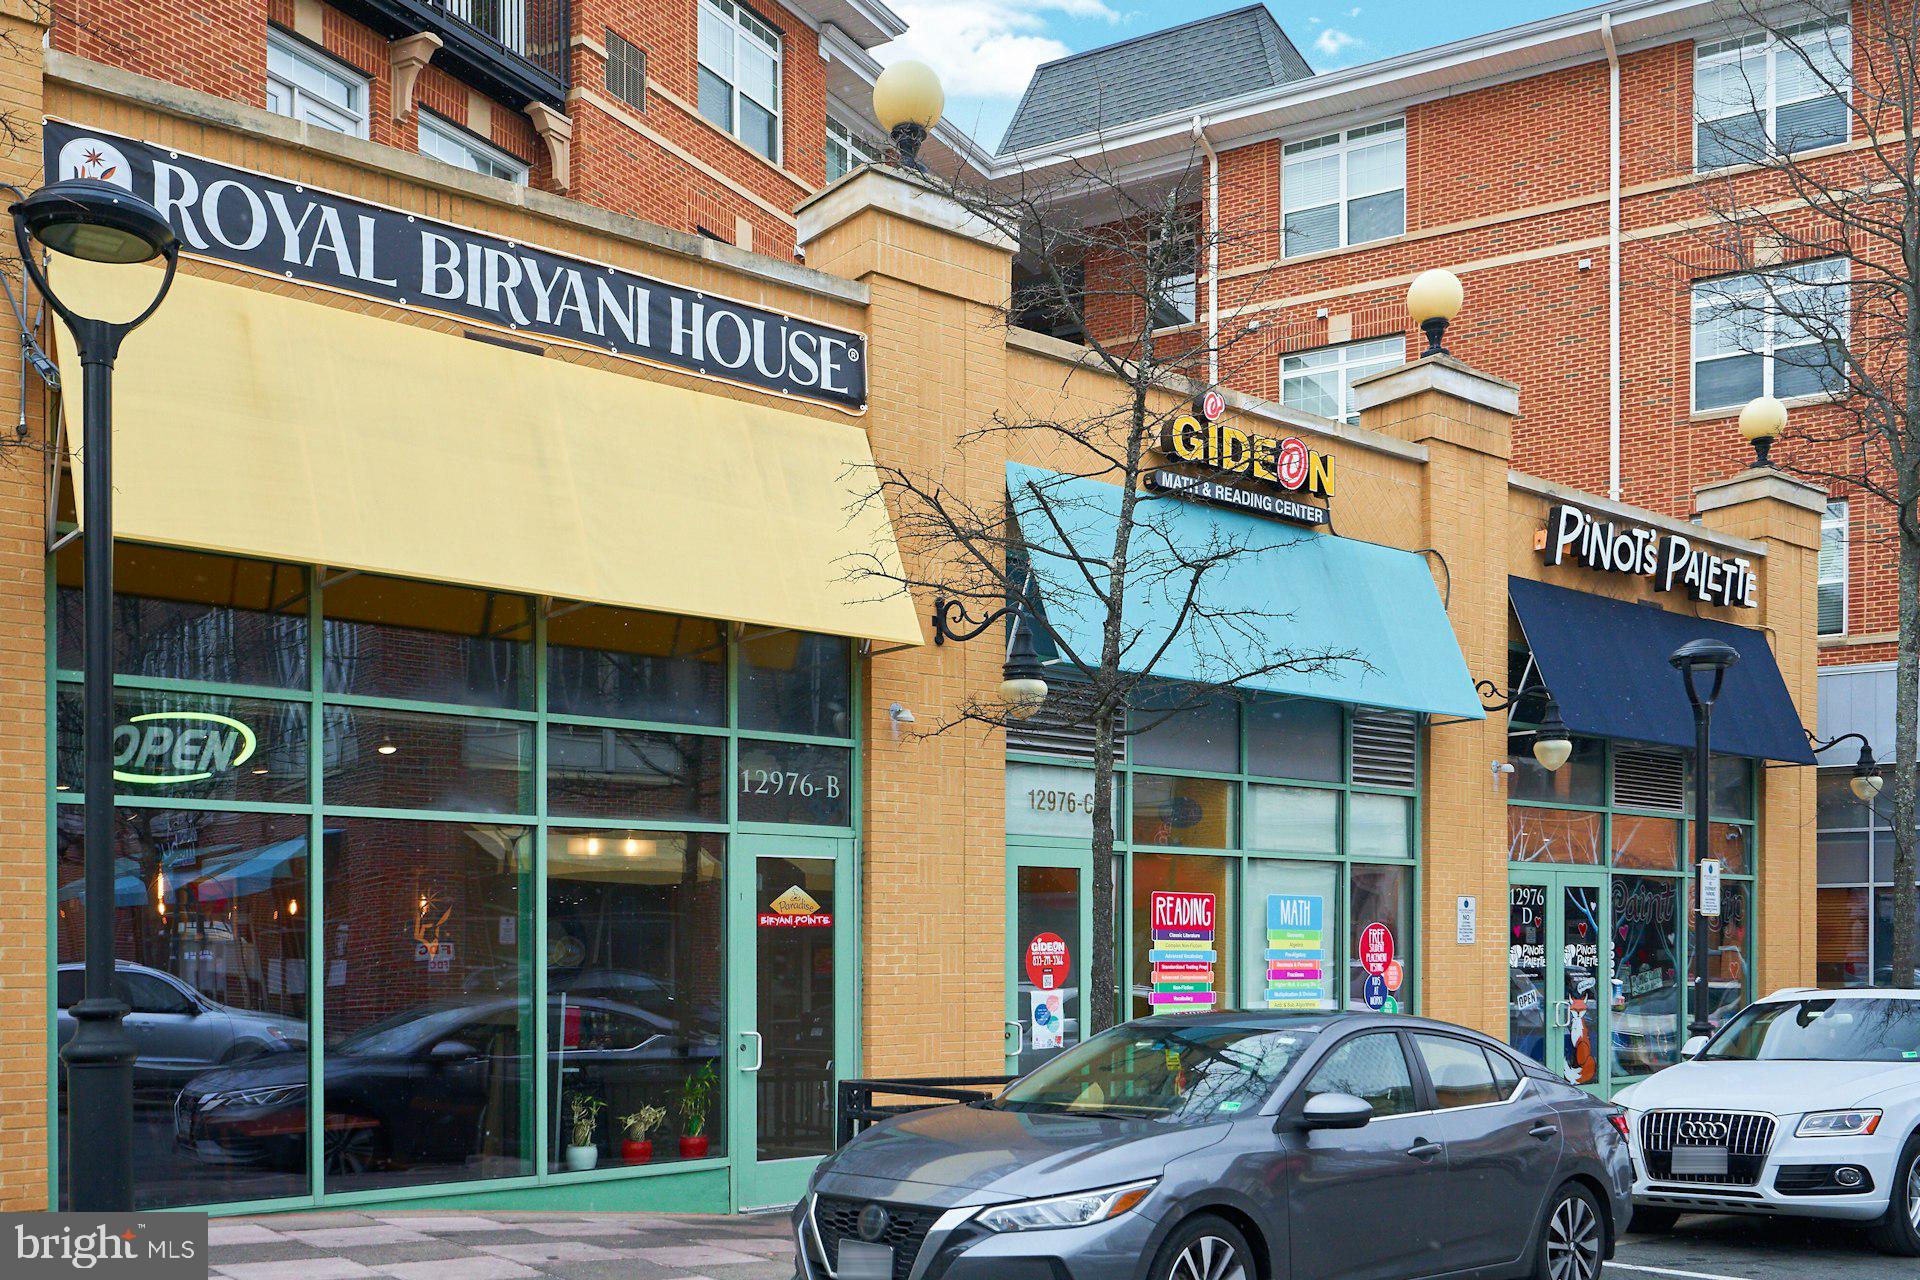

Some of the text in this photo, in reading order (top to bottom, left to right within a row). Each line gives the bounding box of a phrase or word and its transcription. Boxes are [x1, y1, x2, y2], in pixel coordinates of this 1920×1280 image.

[152, 160, 397, 288] ROYAL
[420, 231, 651, 347] BIRYANI
[1162, 472, 1323, 523] MATH & READING CENTER
[1665, 534, 1758, 608] PALETTE
[113, 724, 239, 772] OPEN
[740, 769, 840, 799] 12976-B
[1028, 789, 1093, 815] 12976-C
[778, 900, 814, 913] Paradise
[1510, 887, 1545, 906] 12976
[760, 914, 831, 926] BIRYANI POINTE
[1156, 896, 1211, 927] READING
[1280, 899, 1311, 926] MATH
[1522, 907, 1533, 925] D
[1518, 991, 1536, 1008] OPEN
